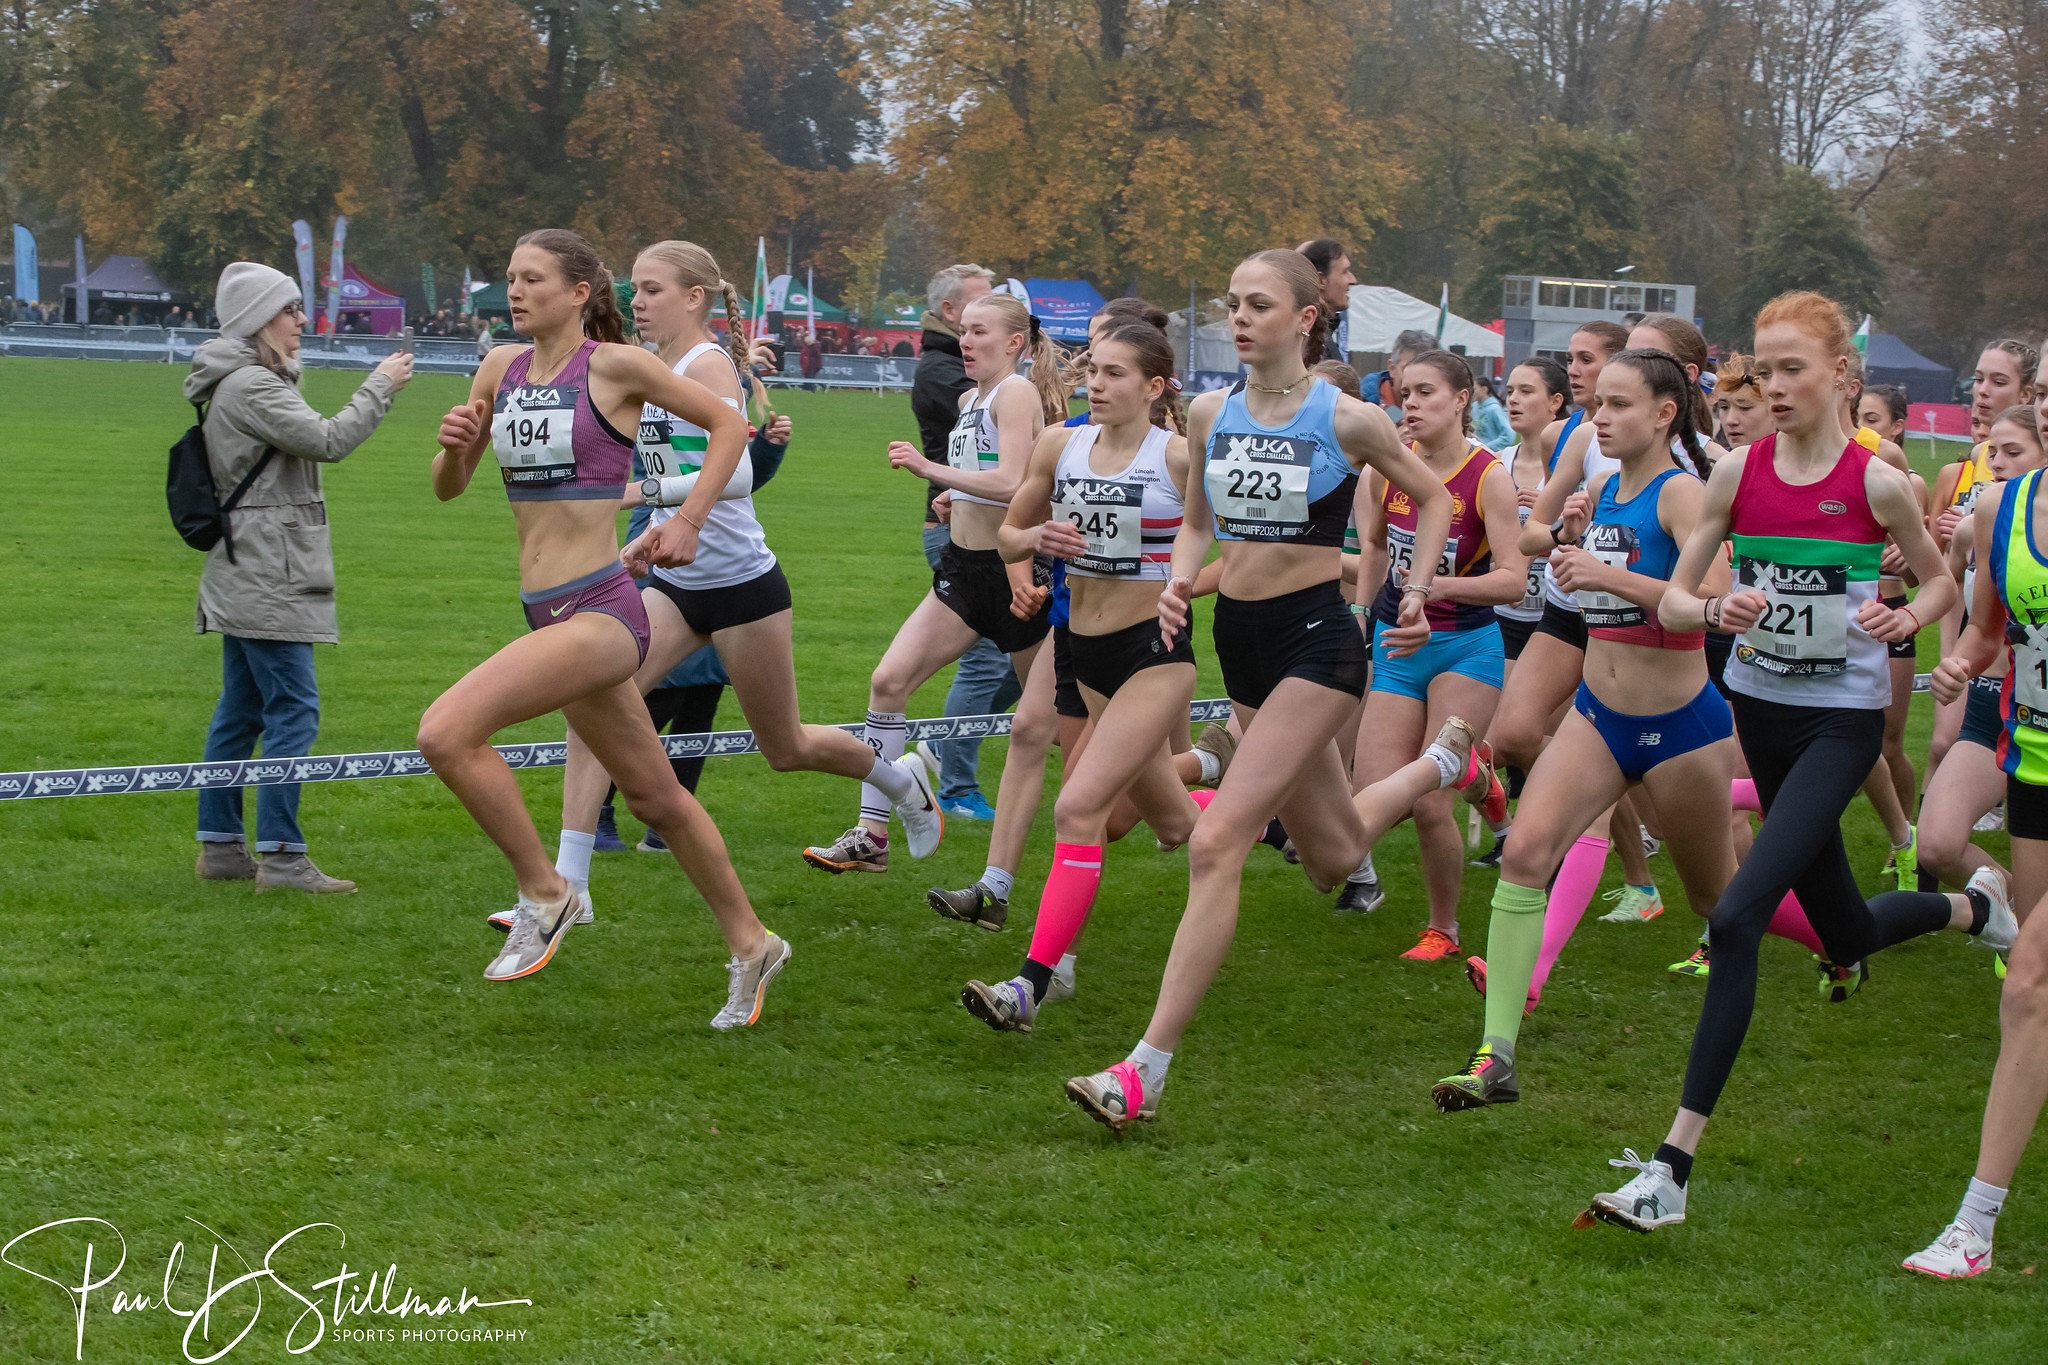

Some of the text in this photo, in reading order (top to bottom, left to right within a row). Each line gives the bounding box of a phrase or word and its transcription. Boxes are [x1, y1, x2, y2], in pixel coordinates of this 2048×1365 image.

[506, 417, 551, 448] 194
[951, 434, 968, 457] 197
[641, 451, 665, 475] 00
[1250, 450, 1295, 462] CROSS CHALLENGE
[1128, 475, 1161, 483] Wellington
[1227, 469, 1282, 501] 223
[1100, 495, 1126, 503] CHALLENGE
[1821, 503, 1846, 514] wasp
[1068, 511, 1119, 539] 245
[1227, 523, 1280, 537] CARDIFF2024
[1073, 556, 1114, 571] CARDIFF2024
[1774, 582, 1828, 591] CROSS CHALLENGE
[1758, 600, 1813, 637] 221
[1754, 656, 1812, 674] CARDIFF2024
